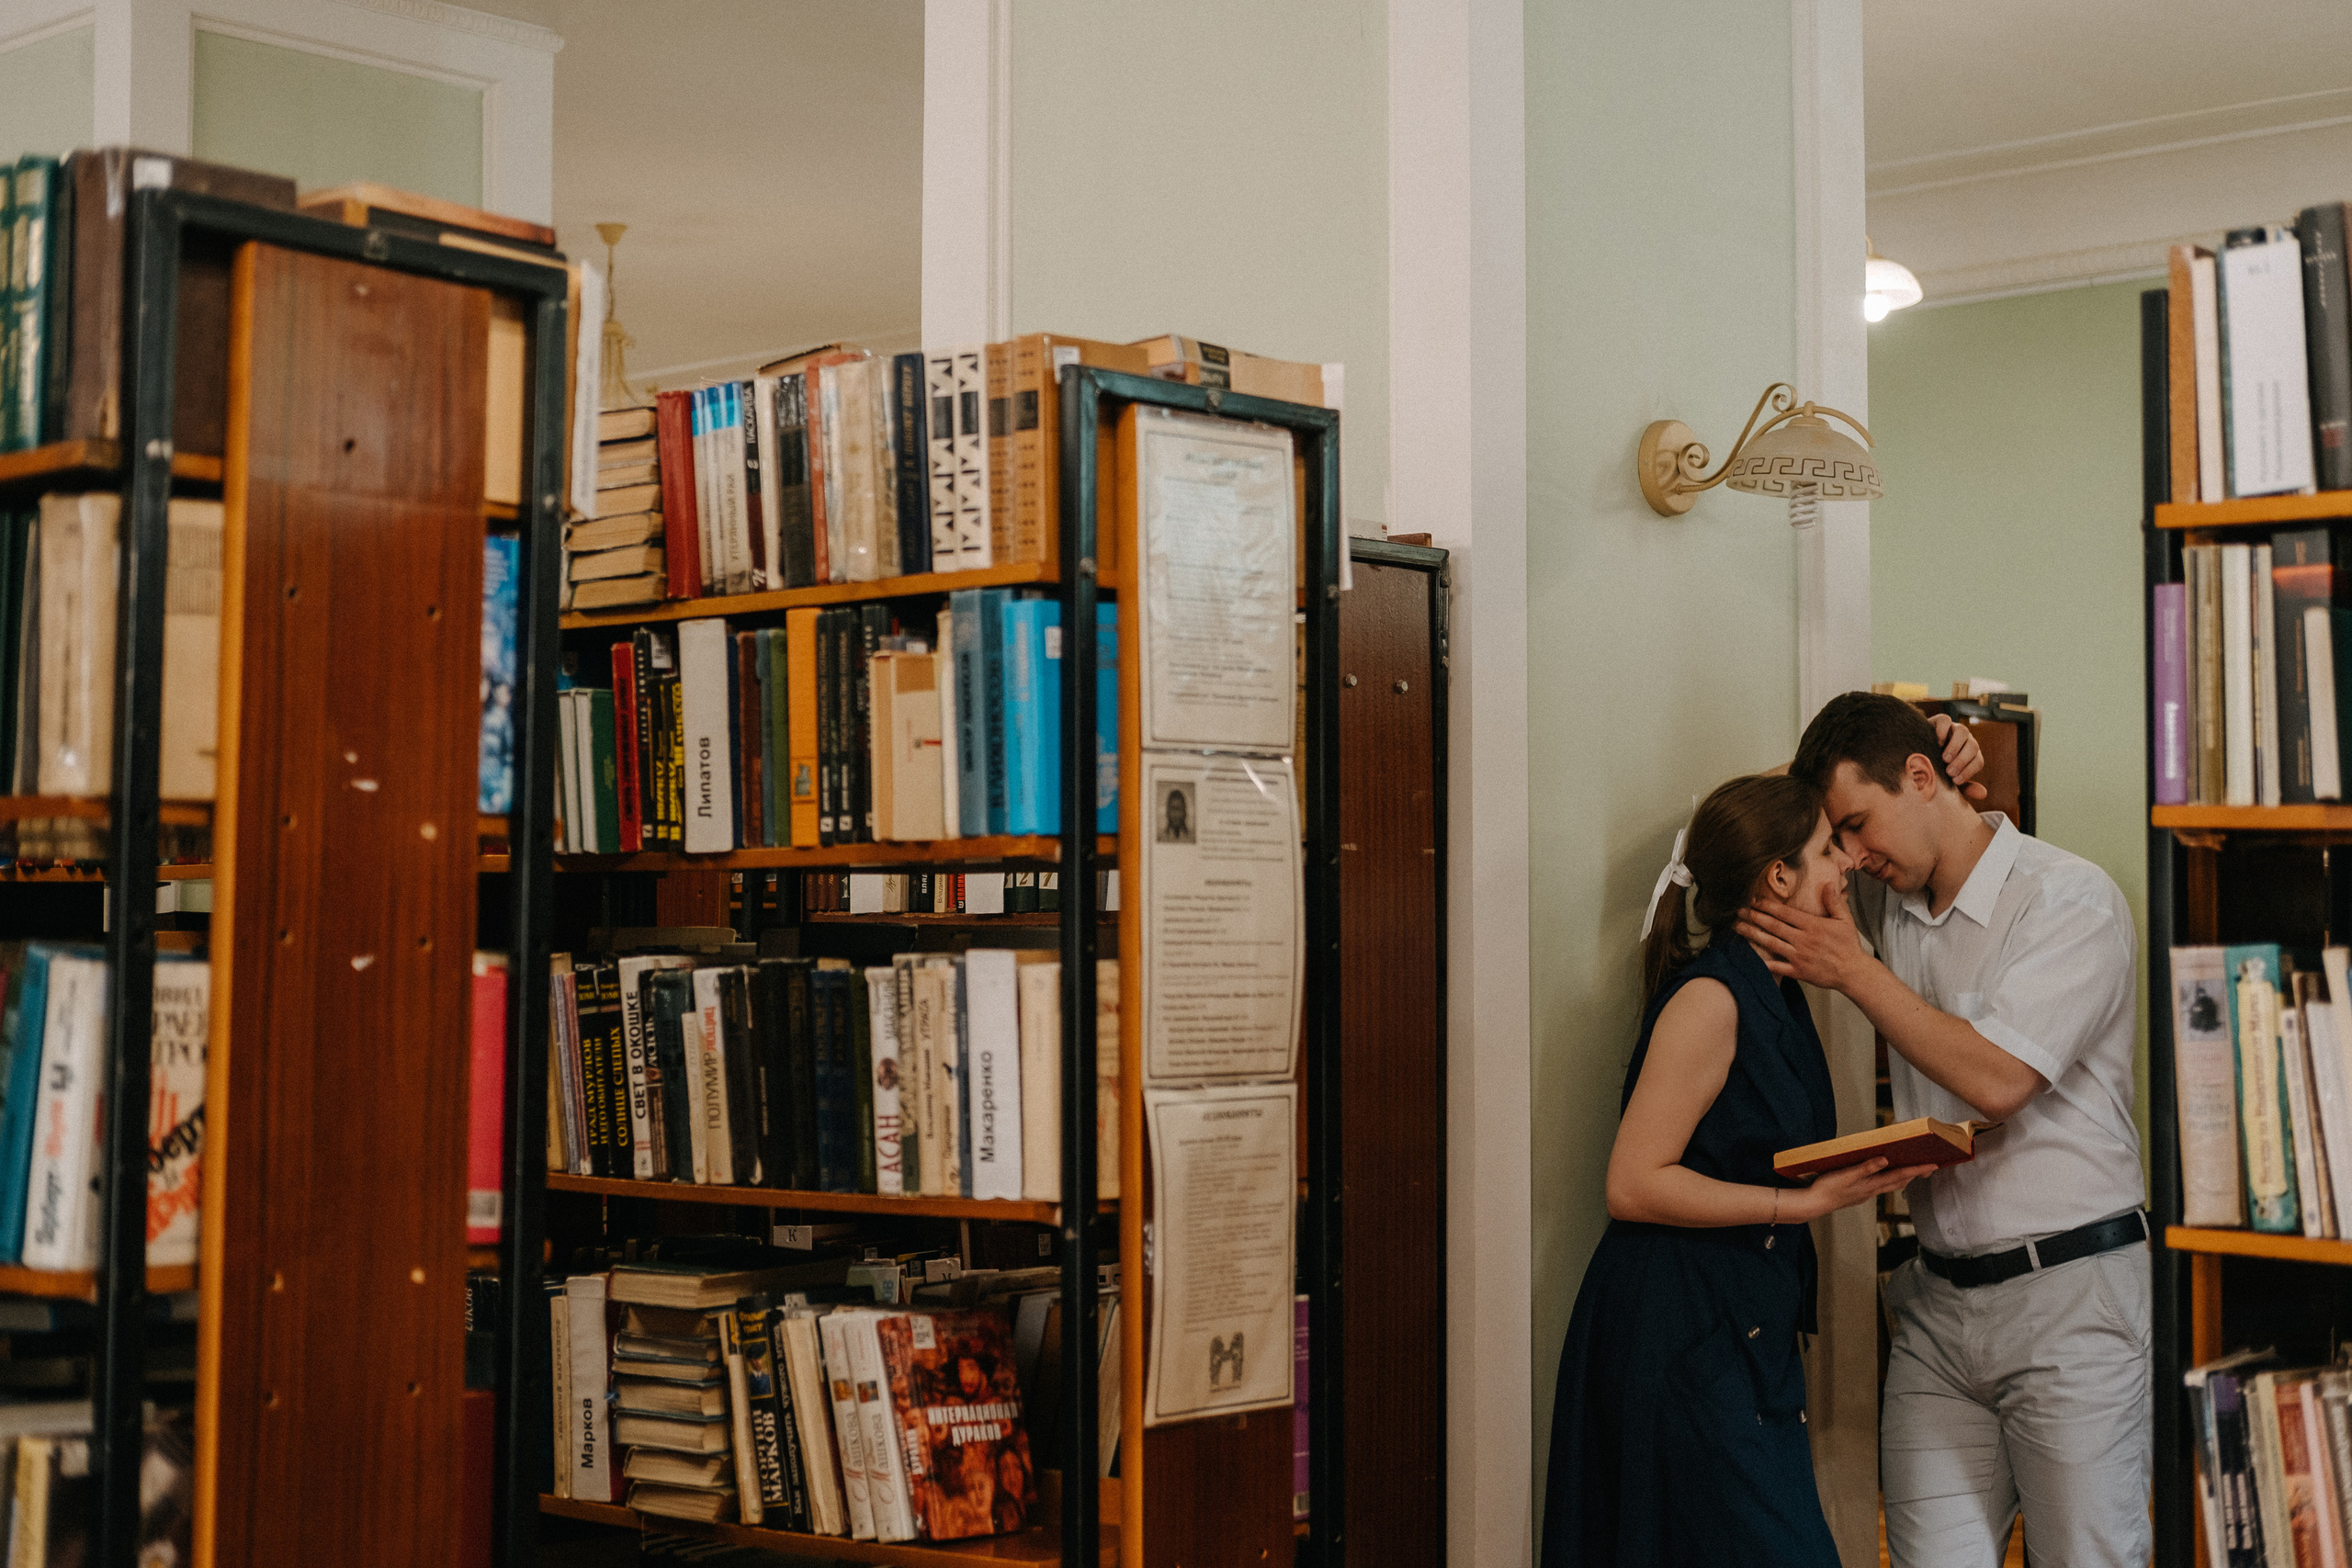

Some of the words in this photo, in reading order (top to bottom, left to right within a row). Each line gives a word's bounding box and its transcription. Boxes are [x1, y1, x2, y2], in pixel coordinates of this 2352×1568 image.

[697, 737, 712, 818] Липатов
[627, 991, 642, 1059] ОКОШКЕ
[582, 1038, 595, 1104] МУРЛОВ
[594, 1037, 606, 1110] ОБИТАТЕЛИ
[609, 1026, 624, 1086] СЛЕПЫХ
[630, 1065, 643, 1075] В
[613, 1088, 628, 1146] СОЛНЦЕ
[632, 1083, 647, 1119] СВЕТ
[704, 1052, 722, 1130] ПОЛУМИР
[978, 1051, 998, 1163] Макаренко
[586, 1106, 598, 1145] ГРАД
[596, 1111, 608, 1133] ЕГО
[876, 1114, 901, 1173] АСАН
[787, 1228, 797, 1242] К
[580, 1398, 596, 1469] Марков
[762, 1412, 784, 1501] МАРКОВ
[951, 1423, 1002, 1448] ДУРАКОВ
[793, 1490, 803, 1515] Как
